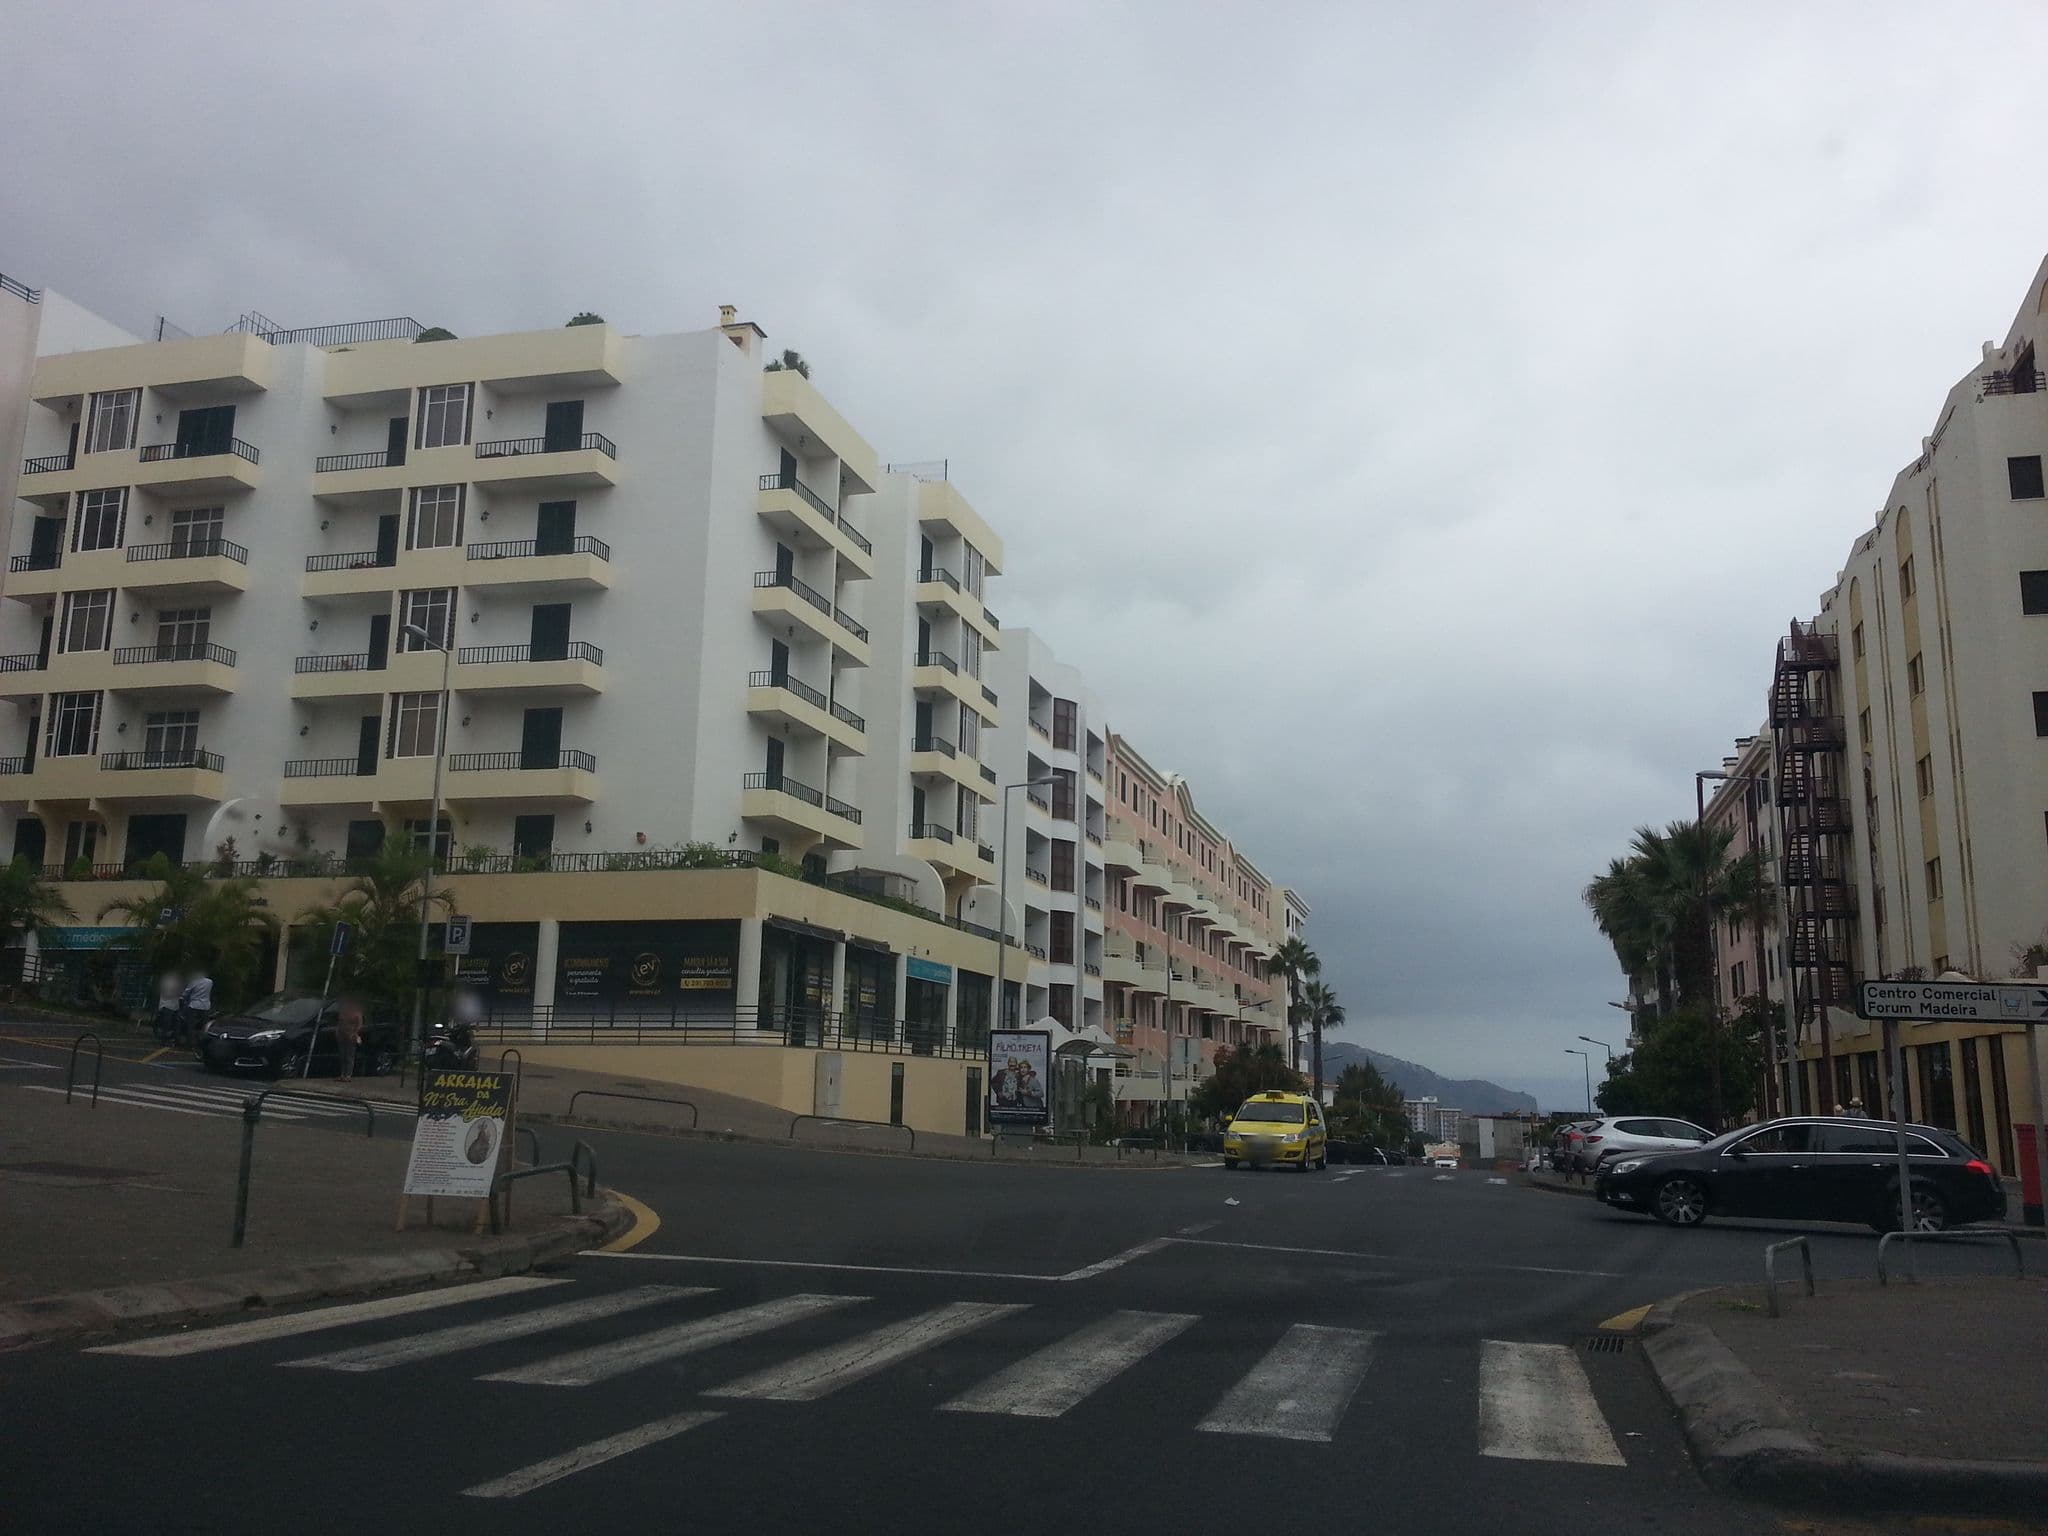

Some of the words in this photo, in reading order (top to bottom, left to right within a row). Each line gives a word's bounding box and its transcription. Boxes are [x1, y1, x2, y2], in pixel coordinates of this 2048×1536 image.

[452, 927, 463, 943] P
[1867, 986, 1917, 1000] Centro
[1922, 987, 1997, 1001] Comercial
[1867, 1001, 1912, 1014] Forum
[1920, 1002, 1978, 1016] Madeira
[434, 1074, 502, 1089] ARRAIAL
[476, 1090, 490, 1100] DA
[461, 1100, 506, 1123] Ajuda
